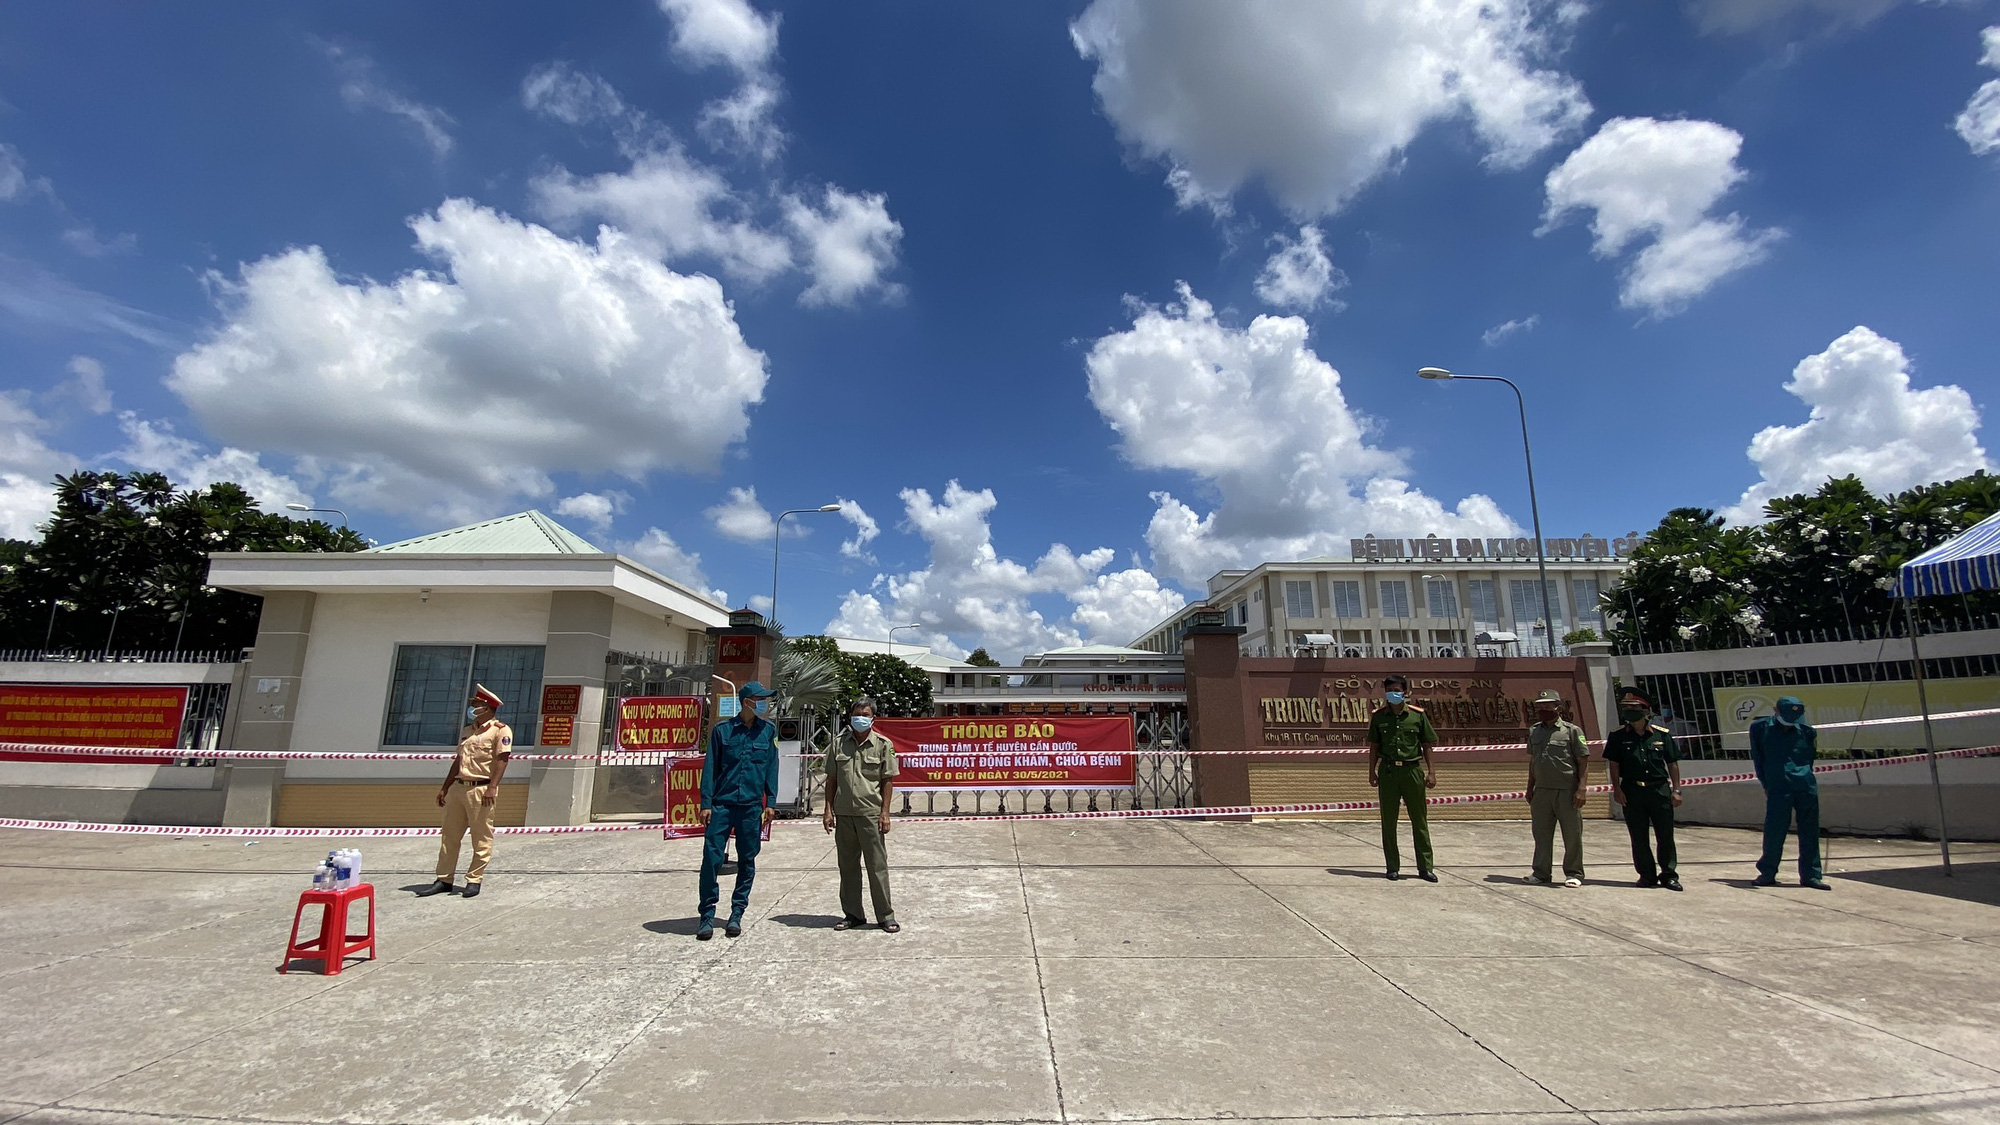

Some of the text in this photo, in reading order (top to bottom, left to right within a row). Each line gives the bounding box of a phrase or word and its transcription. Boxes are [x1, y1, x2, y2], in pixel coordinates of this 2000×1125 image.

[1456, 538, 1485, 558] ĐA
[1117, 655, 1127, 663] D
[1083, 684, 1116, 692] KHOA
[1335, 674, 1361, 689] SỞ
[1364, 679, 1377, 689] Y
[1410, 679, 1460, 690] LONG
[1468, 679, 1493, 690] AN
[622, 705, 639, 720] KHU
[640, 702, 656, 723] VỰC
[656, 704, 683, 720] PHONG
[684, 699, 699, 720] TỎA
[1260, 697, 1323, 724] TRUNG
[1327, 691, 1369, 724] TÂM
[621, 722, 697, 745] CẤM RA VÀO
[940, 721, 1055, 740] THÔNG BÁO
[1264, 733, 1279, 741] Khu
[1280, 733, 1290, 741] 1B
[1292, 733, 1302, 741] TT
[917, 743, 949, 752] TRUNG
[951, 742, 972, 752] TÂM
[974, 744, 981, 752] Y
[982, 741, 995, 752] TẾ
[1052, 741, 1078, 751] ĐƯỚC
[946, 757, 976, 770] HOẠT
[979, 755, 1011, 769] ĐỘNG
[1055, 754, 1087, 767] CHỮA
[1090, 754, 1122, 769] BỆNH
[670, 770, 693, 791] KHU
[927, 771, 943, 780] TỪ
[955, 771, 975, 780] GIỜ
[978, 770, 1009, 780] NGÀY
[1013, 771, 1069, 779] 30/5/2021
[671, 795, 702, 825] CẤ
